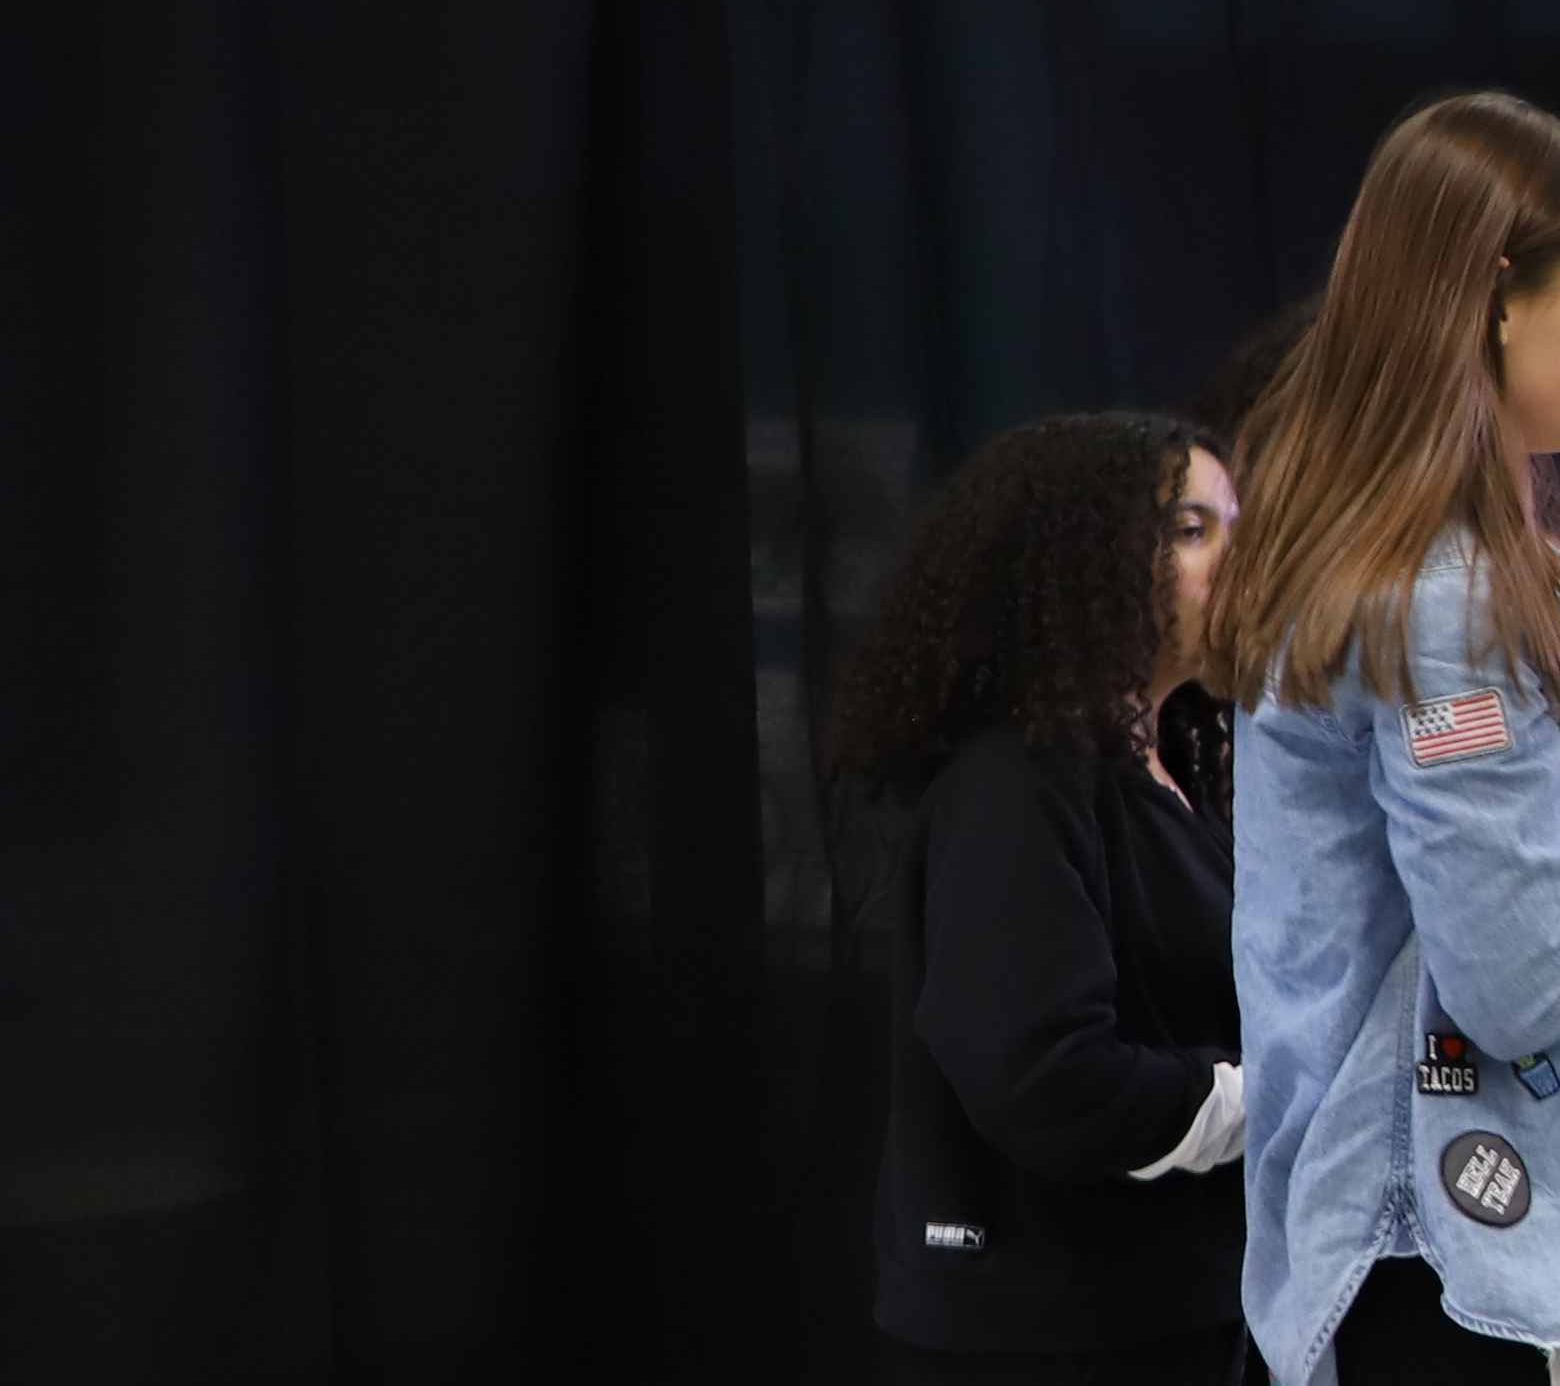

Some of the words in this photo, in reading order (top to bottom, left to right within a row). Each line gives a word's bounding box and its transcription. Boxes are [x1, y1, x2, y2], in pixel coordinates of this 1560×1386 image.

[1427, 1034, 1438, 1060] I
[1418, 1065, 1476, 1092] TACOS
[1455, 1144, 1500, 1200] HELL
[1480, 1157, 1522, 1216] YEAH
